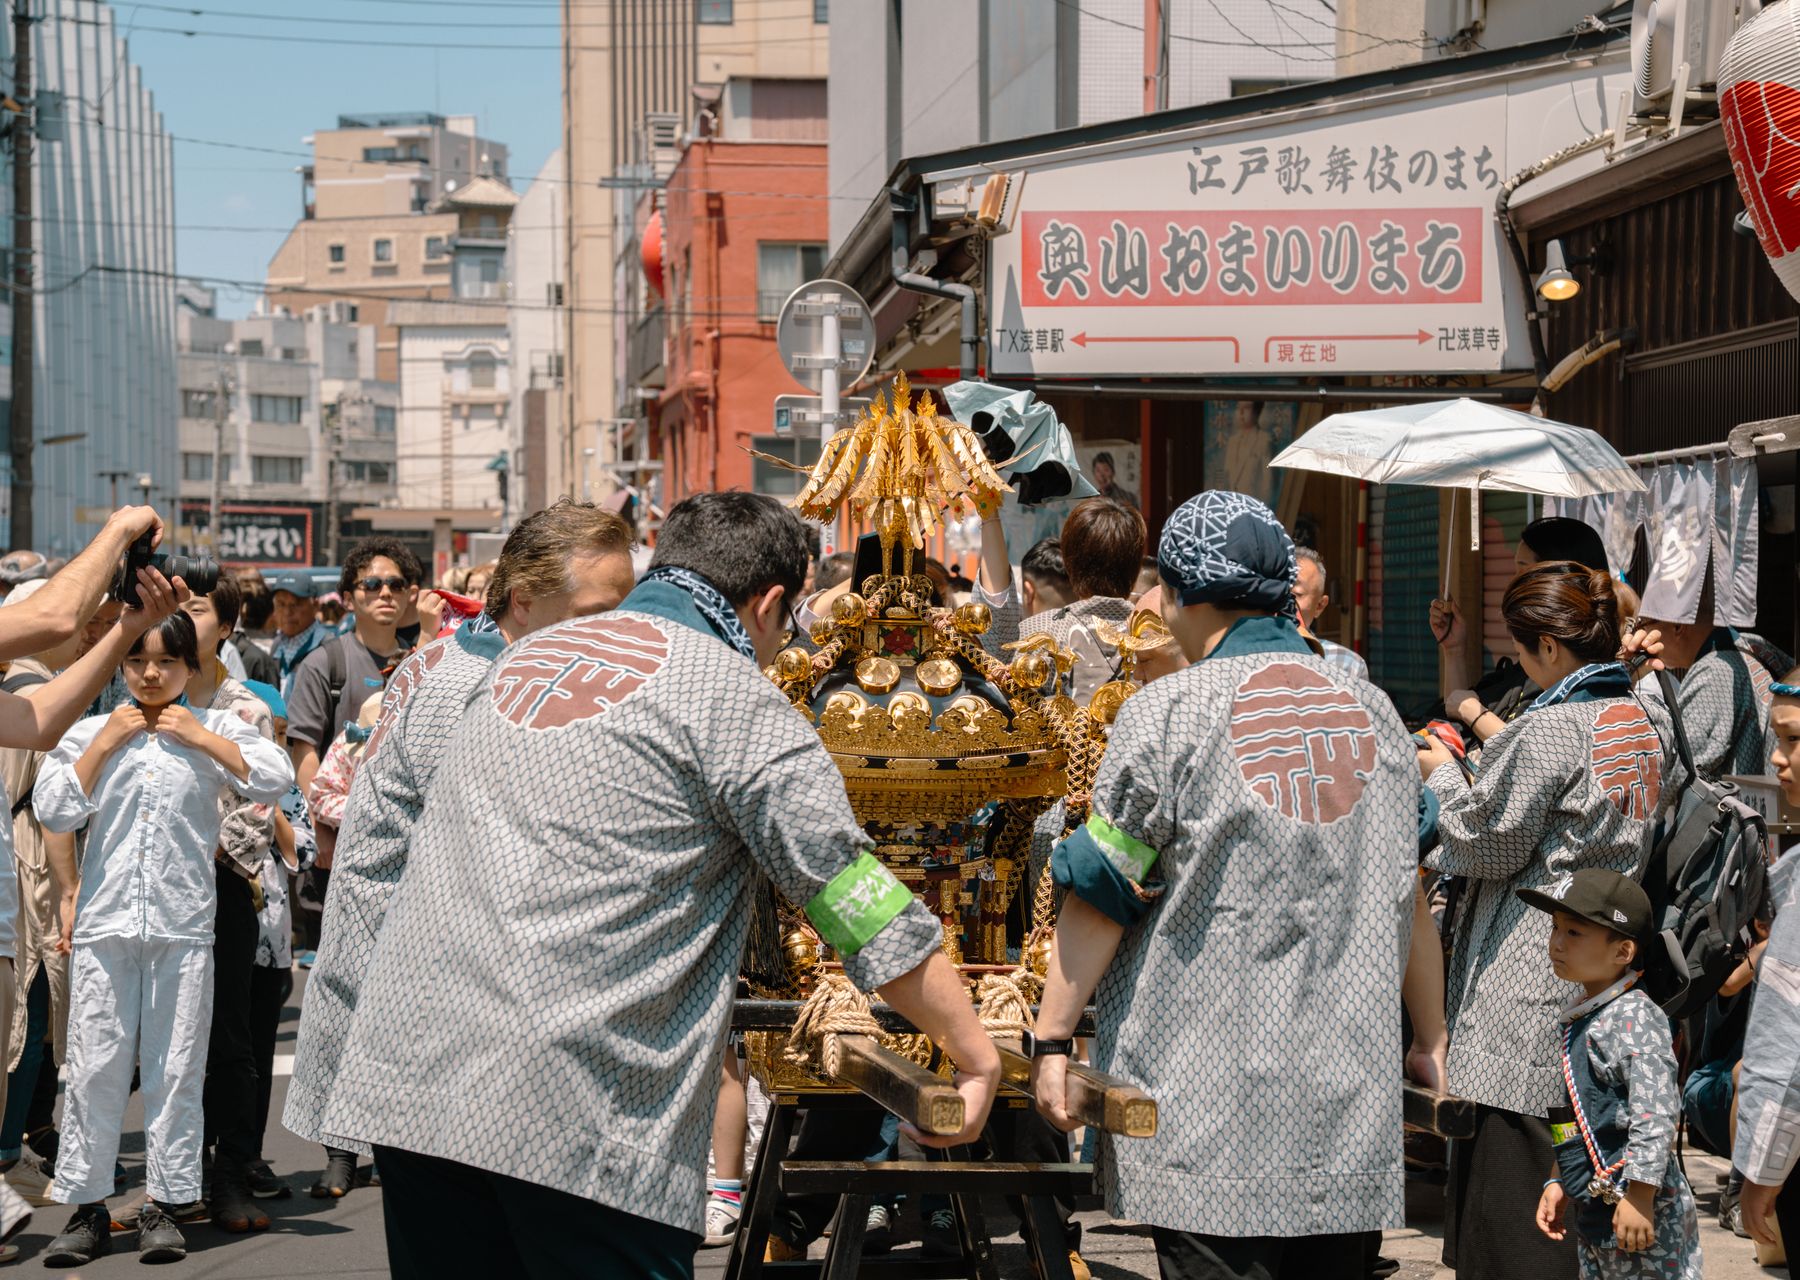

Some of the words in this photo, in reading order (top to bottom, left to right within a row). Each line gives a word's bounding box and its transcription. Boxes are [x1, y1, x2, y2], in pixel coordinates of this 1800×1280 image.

[1187, 145, 1498, 195] 江戸歌舞伎のまち
[1038, 219, 1465, 298] 奥山おまいりまち
[995, 328, 1065, 353] TX浅草駅
[1276, 343, 1337, 362] 現在地
